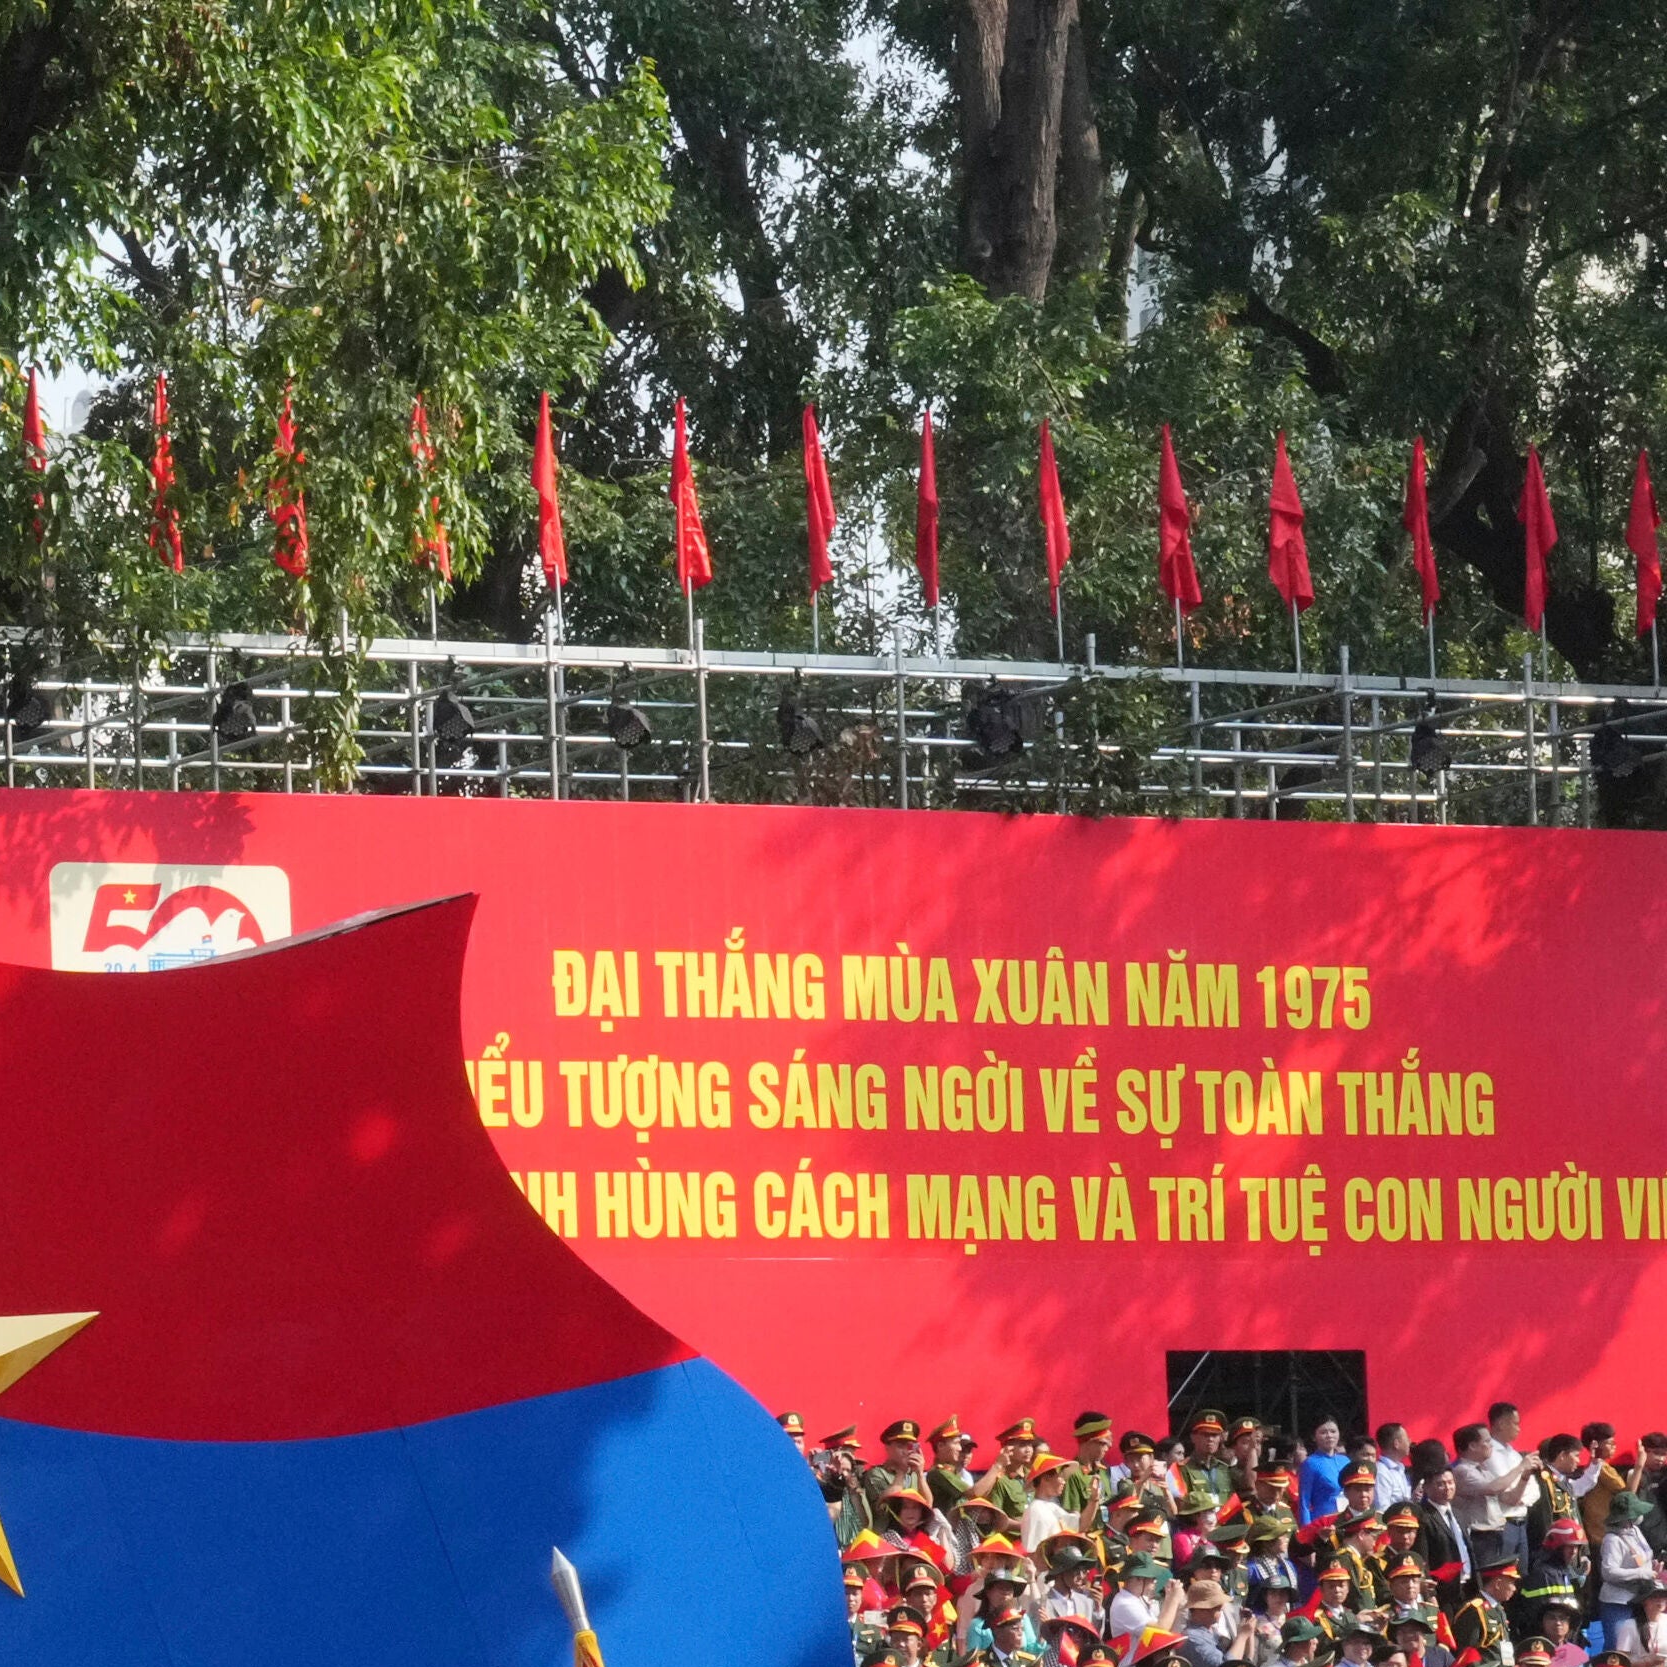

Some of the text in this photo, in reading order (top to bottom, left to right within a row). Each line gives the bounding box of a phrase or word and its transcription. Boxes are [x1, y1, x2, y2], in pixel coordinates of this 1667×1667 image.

[552, 926, 1371, 1033] ĐẠI THẮNG MÙA XUÂN NĂM 1975
[558, 1054, 732, 1144] TƯỢNG
[747, 1048, 888, 1130] SÁNG
[903, 1050, 1025, 1133] NGỜI
[1038, 1047, 1100, 1133] VỀ
[1116, 1063, 1186, 1149] SỰ
[1195, 1057, 1323, 1136] TOÀN
[1336, 1047, 1495, 1136] THẮNG
[594, 1156, 738, 1240] HÙNG
[753, 1157, 891, 1240] CÁCH
[906, 1174, 1057, 1255] MẠNG
[1070, 1162, 1137, 1241] VÀ
[1149, 1163, 1225, 1242] TRÍ
[1239, 1163, 1328, 1256] TUỆ
[1344, 1177, 1443, 1242] CON
[1458, 1161, 1603, 1242] NGƯỜI
[1616, 1176, 1667, 1240] VI
